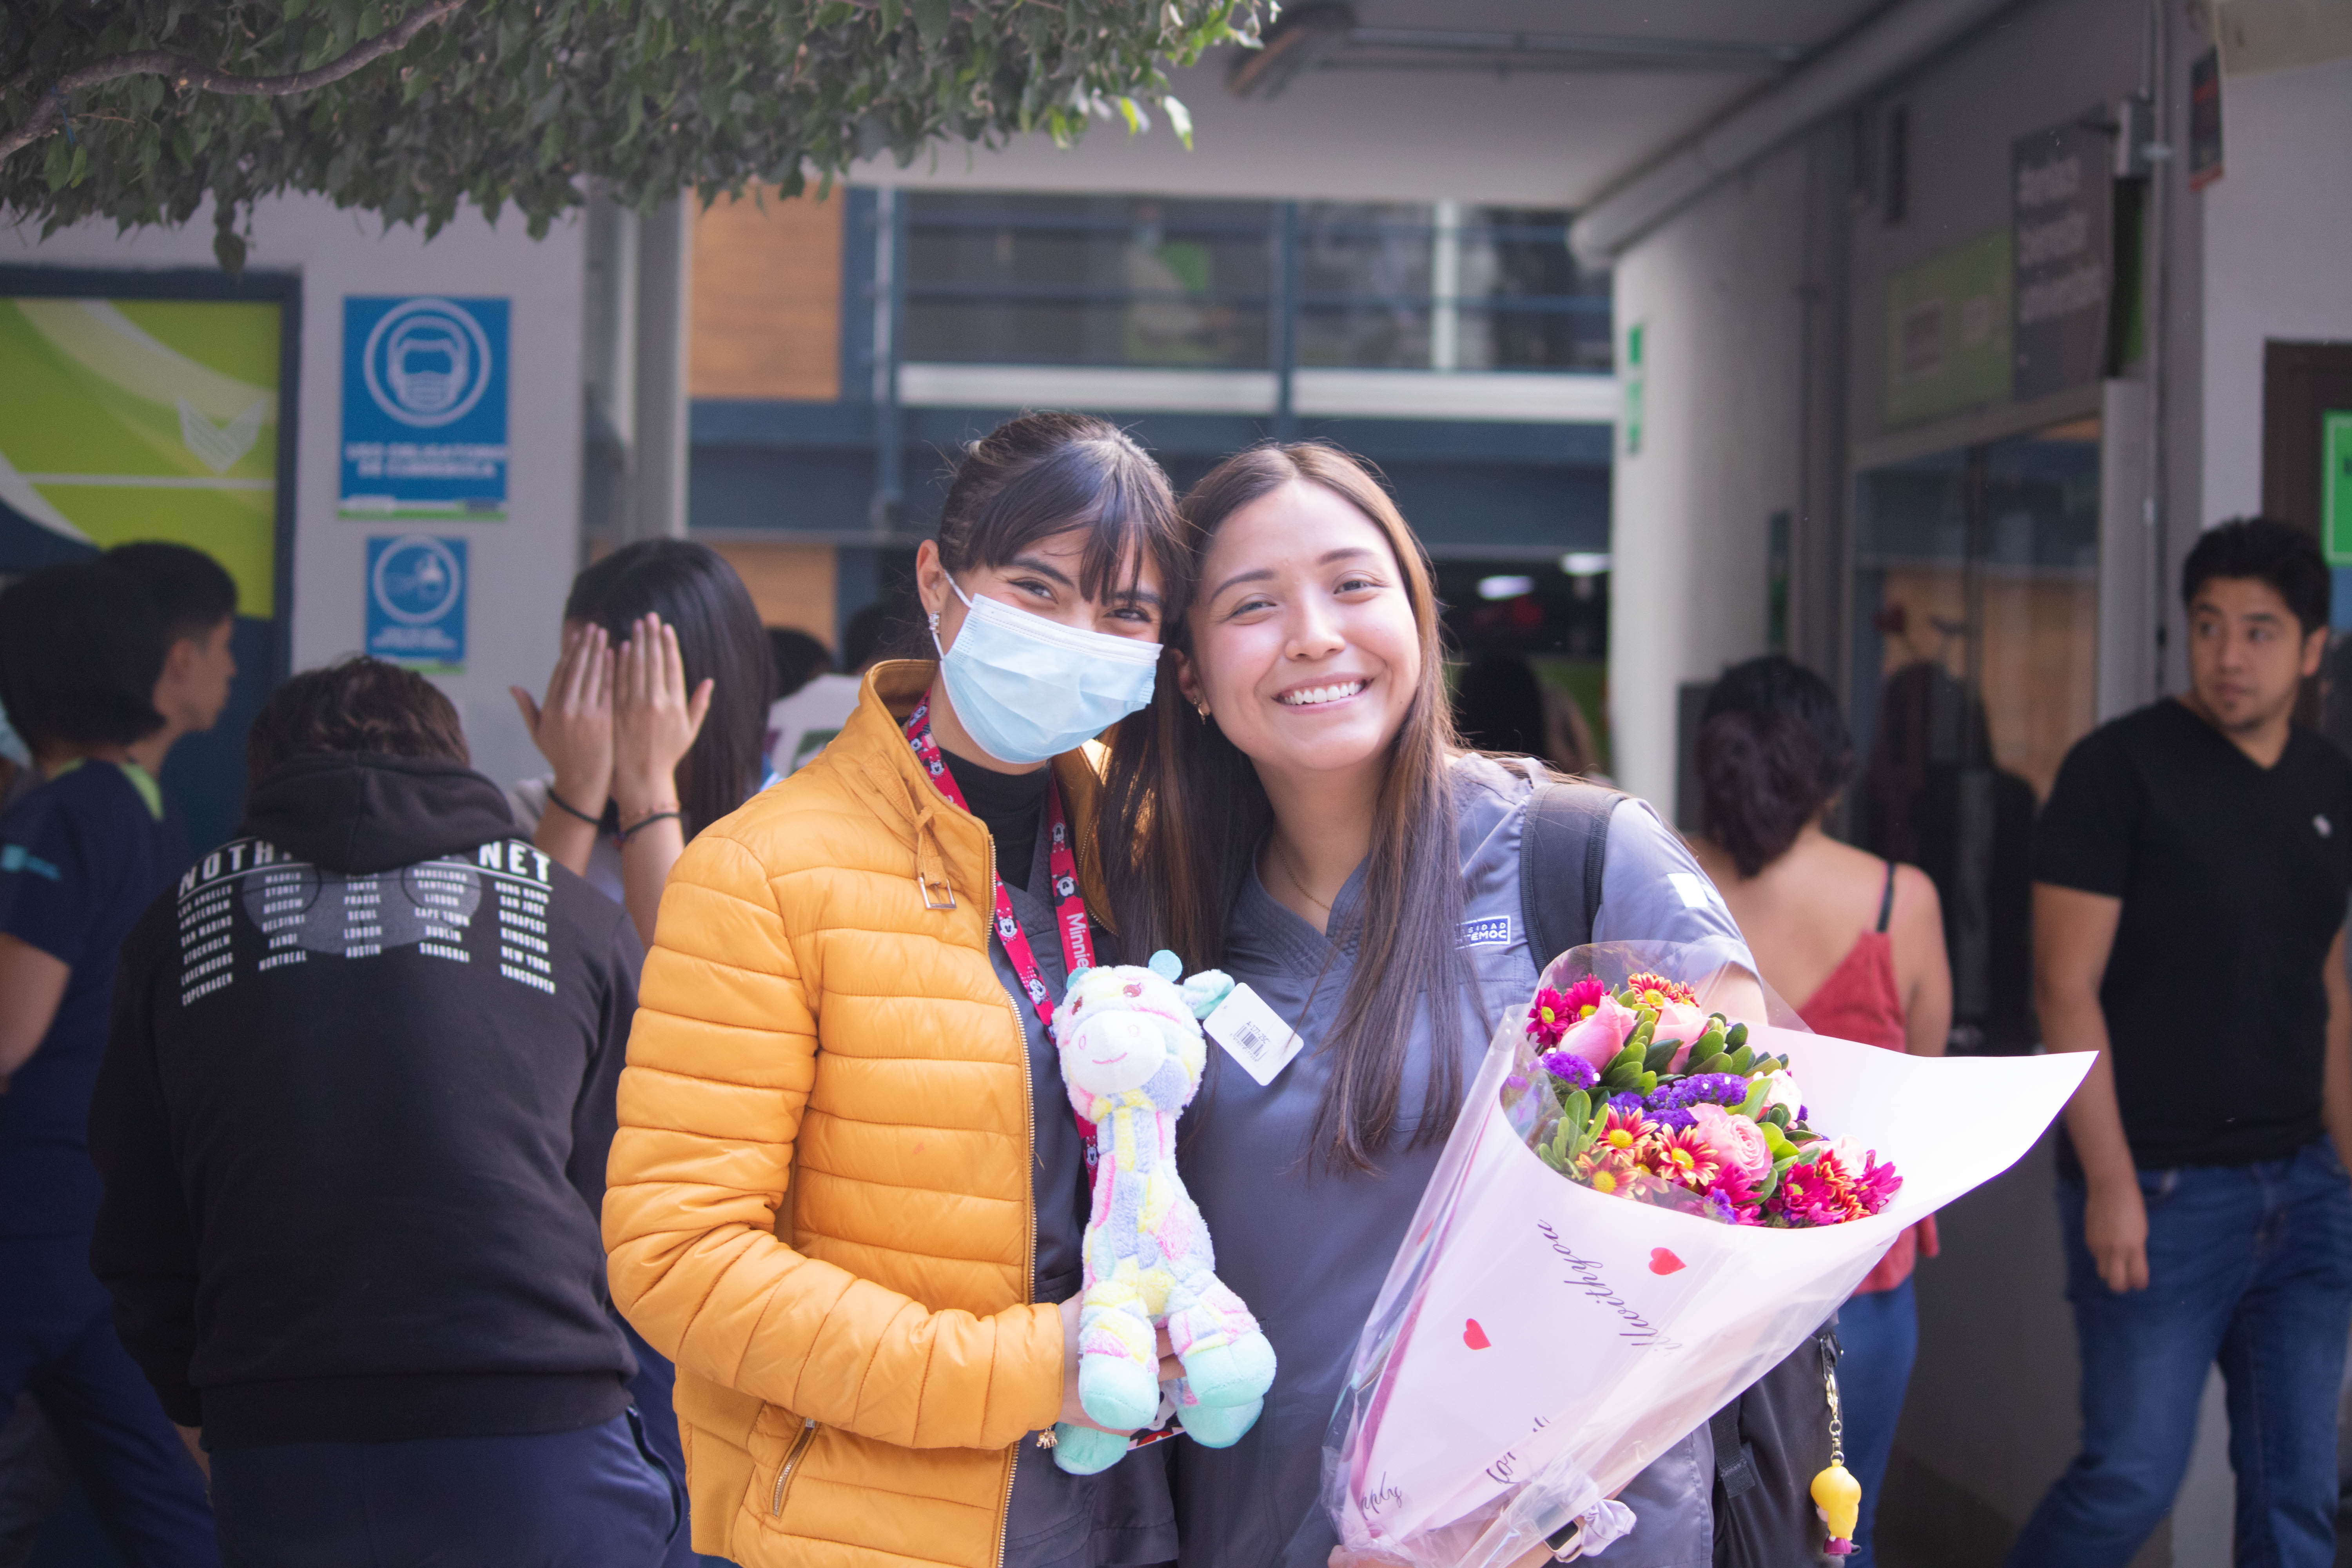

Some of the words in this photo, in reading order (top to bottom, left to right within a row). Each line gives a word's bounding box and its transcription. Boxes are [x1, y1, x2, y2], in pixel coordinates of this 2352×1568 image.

[179, 840, 292, 898] NOTH
[479, 841, 551, 883] NET
[414, 869, 467, 882] BARCELONA
[417, 880, 465, 894] SANTIAGO
[180, 899, 231, 930] AMSTERDAM
[499, 909, 547, 935] BUDAPEST
[344, 926, 382, 940] LONDON
[425, 925, 462, 943] DUBLIN
[500, 927, 548, 954] KINGSTON
[1066, 912, 1091, 967] Minnie
[183, 934, 231, 965] STOCKHOLM
[258, 950, 307, 971] MONTREAL
[346, 944, 382, 958] AUSTIN
[419, 942, 470, 964] SHANGHAI
[501, 945, 524, 963] NEW
[525, 954, 551, 975] YORK
[181, 952, 233, 987] LUXEMBOURG
[500, 963, 556, 995] VANCOUVER
[182, 972, 233, 1007] COPENHAGEN
